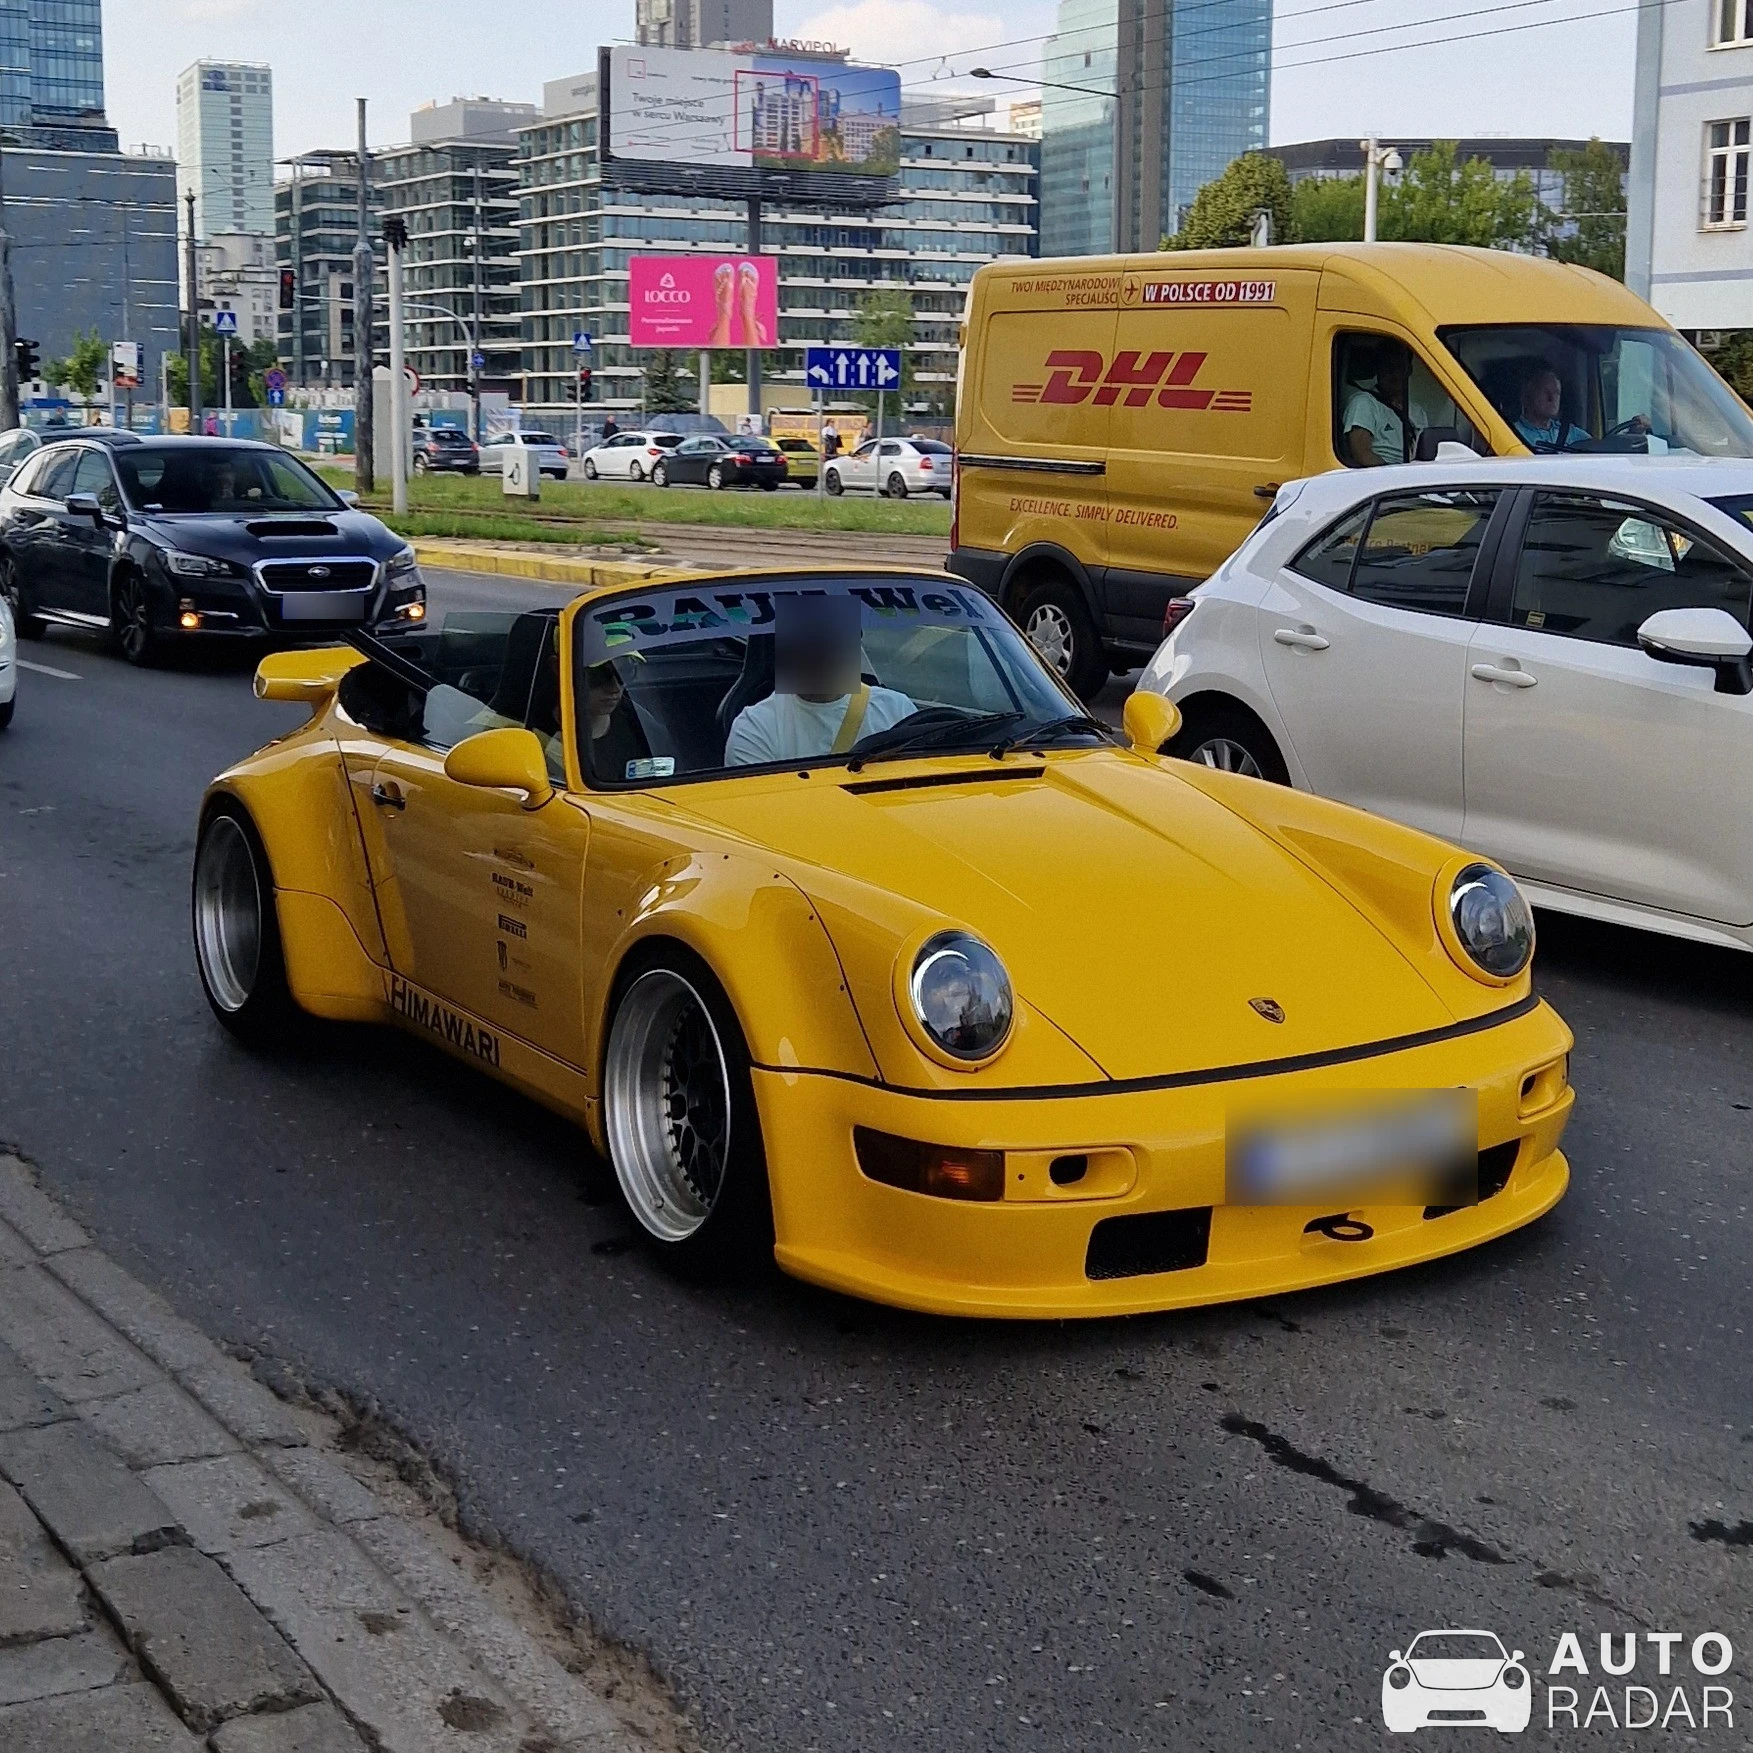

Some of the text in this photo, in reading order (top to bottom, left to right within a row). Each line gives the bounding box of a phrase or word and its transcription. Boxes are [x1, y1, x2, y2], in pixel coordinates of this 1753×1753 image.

[767, 36, 840, 55] MARVIPOL
[632, 91, 664, 107] Twoje
[644, 110, 672, 120] sercu
[1145, 282, 1274, 302] W POLSCE OD 1991
[1038, 349, 1216, 411] DHL
[1009, 497, 1179, 530] EXCELLENCE. SIMPLY DELIVERED.
[594, 589, 830, 649] RAU
[391, 973, 500, 1069] HIMAWARI
